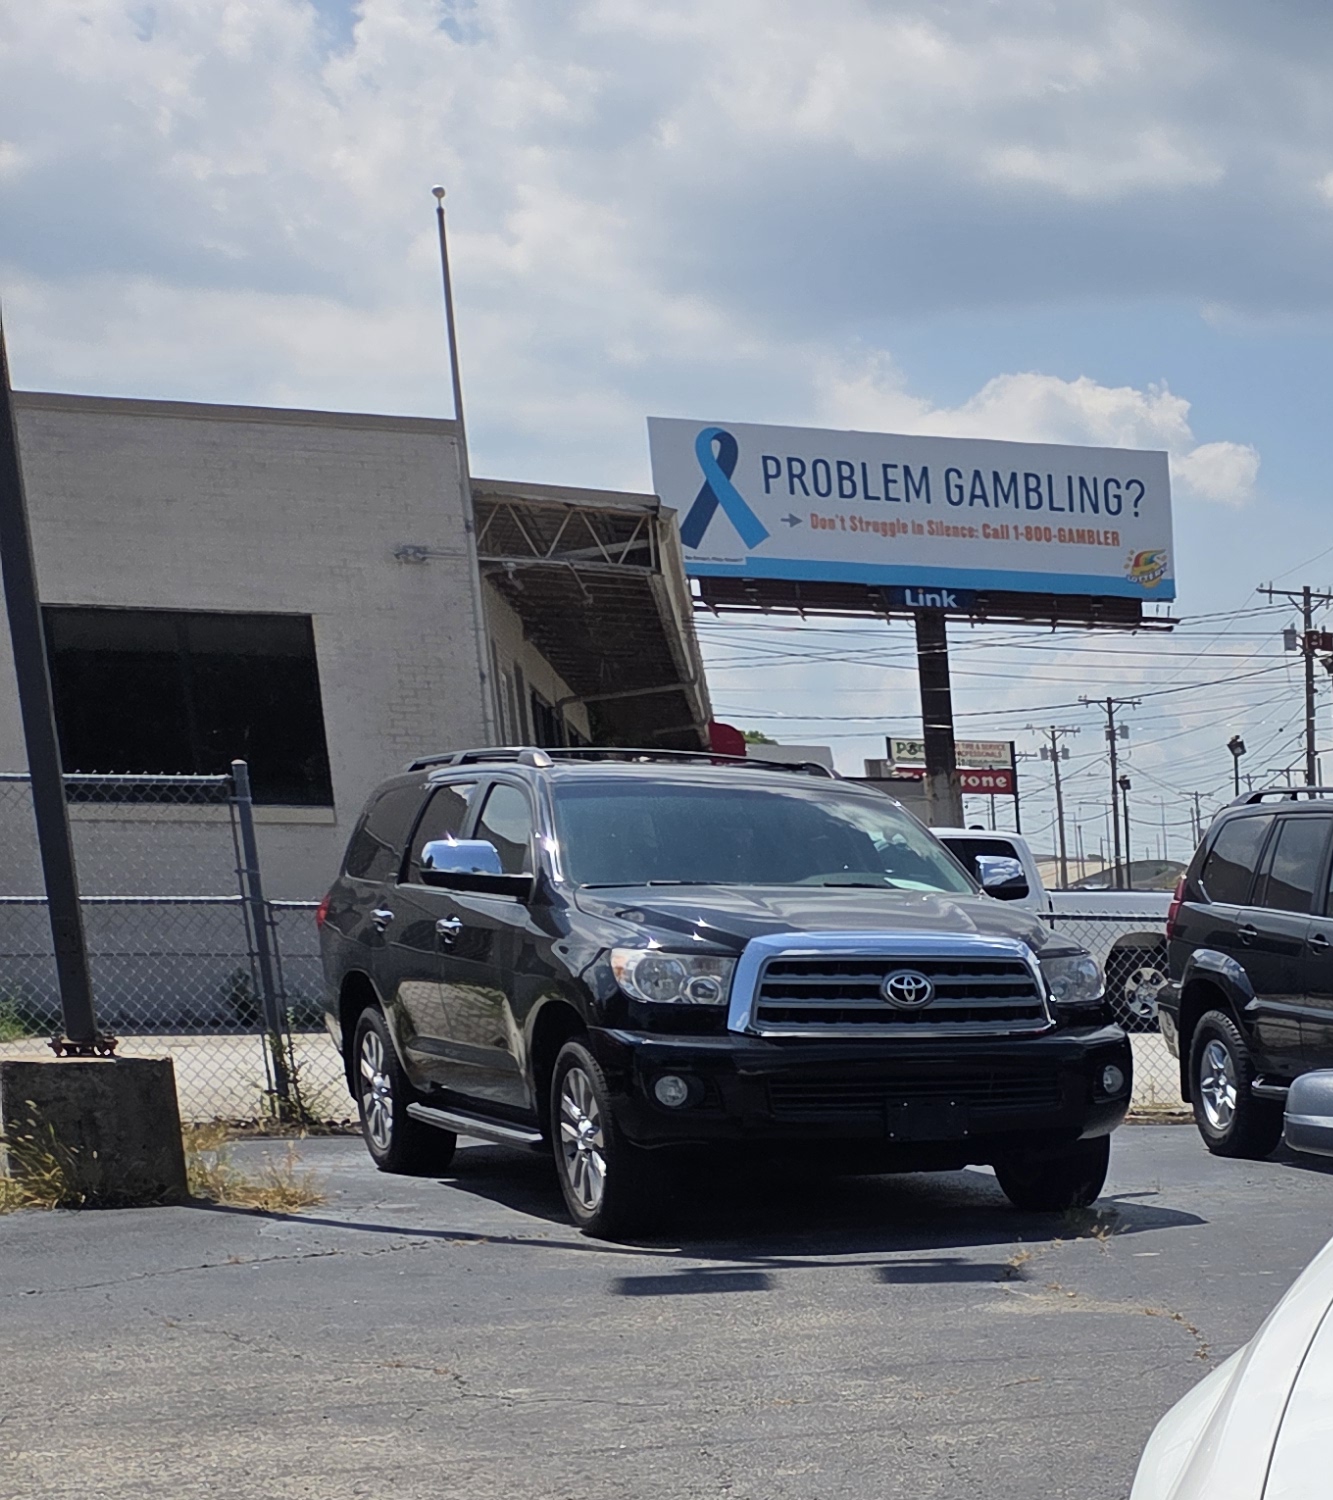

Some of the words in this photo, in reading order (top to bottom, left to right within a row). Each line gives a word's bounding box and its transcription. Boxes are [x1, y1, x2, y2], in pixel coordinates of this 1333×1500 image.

[761, 455, 932, 504] PROBLEM
[944, 467, 1146, 518] GAMBLING?
[810, 513, 847, 532] Don't
[849, 515, 909, 538] Struggle
[927, 519, 979, 539] Silence:
[982, 523, 1010, 540] Call
[1012, 524, 1121, 547] 1-800-GAMBLER
[905, 588, 958, 608] Link
[960, 774, 1008, 788] tone
